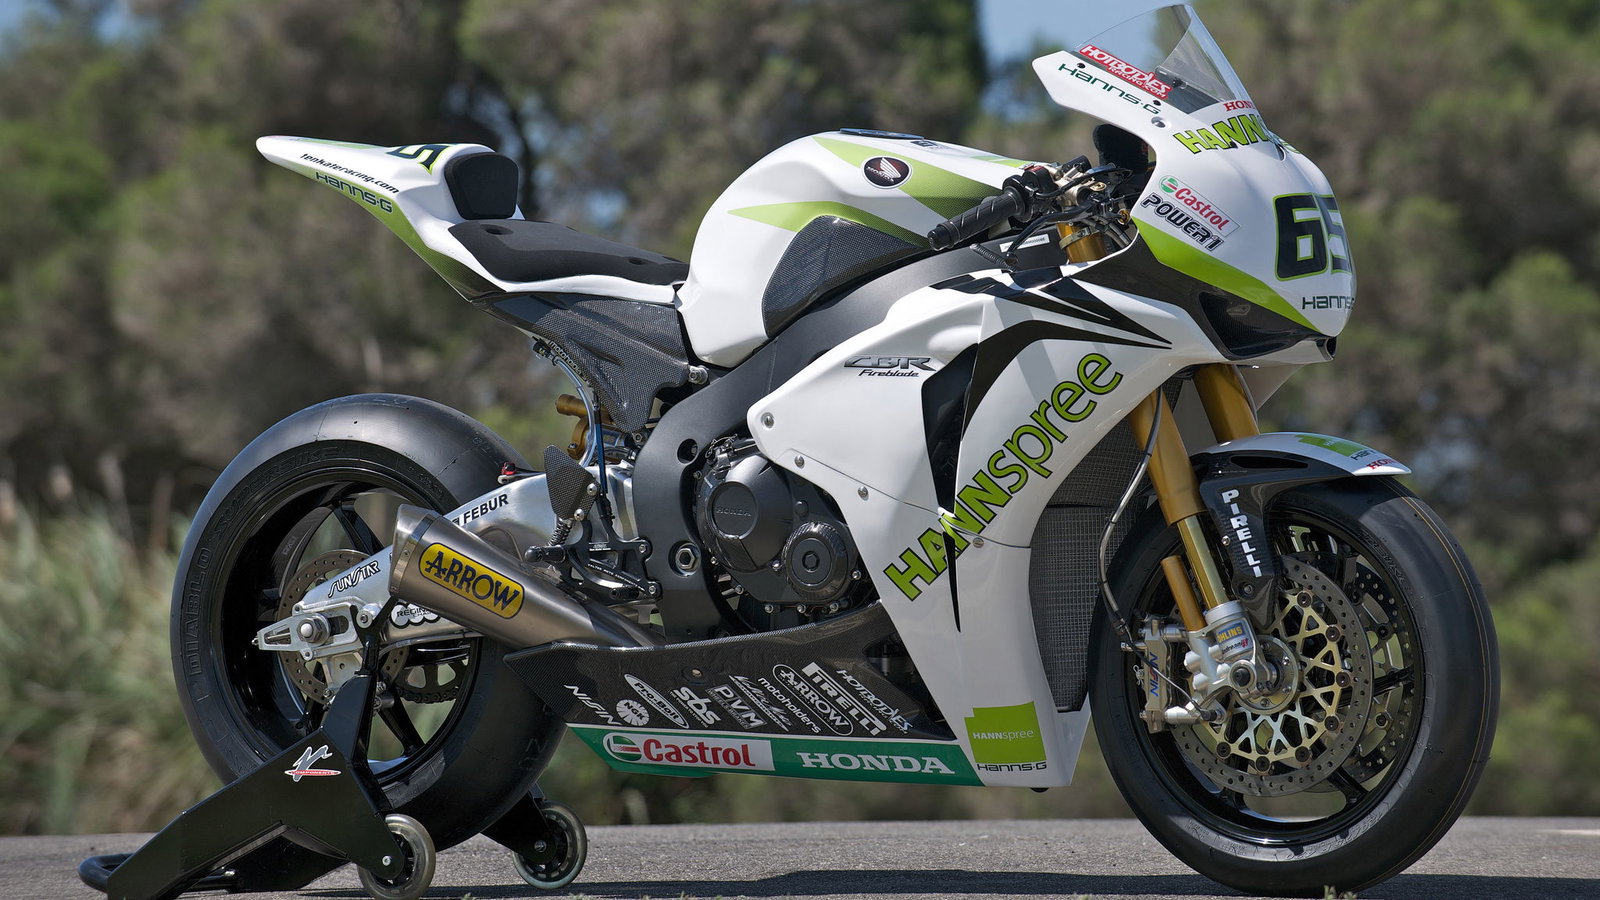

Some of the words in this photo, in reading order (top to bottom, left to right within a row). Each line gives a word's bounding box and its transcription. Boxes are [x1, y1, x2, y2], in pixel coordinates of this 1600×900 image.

[1223, 100, 1256, 112] HON
[1173, 113, 1270, 154] HANN
[300, 153, 400, 194] tenkateracing.com
[1140, 192, 1224, 252] POWER1
[1175, 187, 1230, 231] Castrol
[1273, 193, 1352, 281] 65
[844, 356, 937, 371] CBR
[858, 369, 920, 378] Fireblade
[883, 353, 1123, 601] HANNspree
[463, 493, 509, 524] FEBUR
[715, 507, 752, 517] HONDA
[1221, 489, 1262, 578] PIRELLI
[328, 560, 381, 598] SUNSTAR
[425, 550, 521, 611] ARROW
[397, 607, 429, 617] REGIN
[623, 701, 645, 720] NGK
[634, 682, 679, 719] Pro-Bolt
[673, 686, 721, 724] sbs
[714, 686, 764, 726] PVM
[757, 677, 822, 734] motoholders
[779, 669, 850, 728] ARROW
[802, 661, 887, 736] PIRELLI
[643, 738, 756, 767] Castrol
[972, 729, 1034, 741] HANNspree
[796, 752, 956, 775] HONDA
